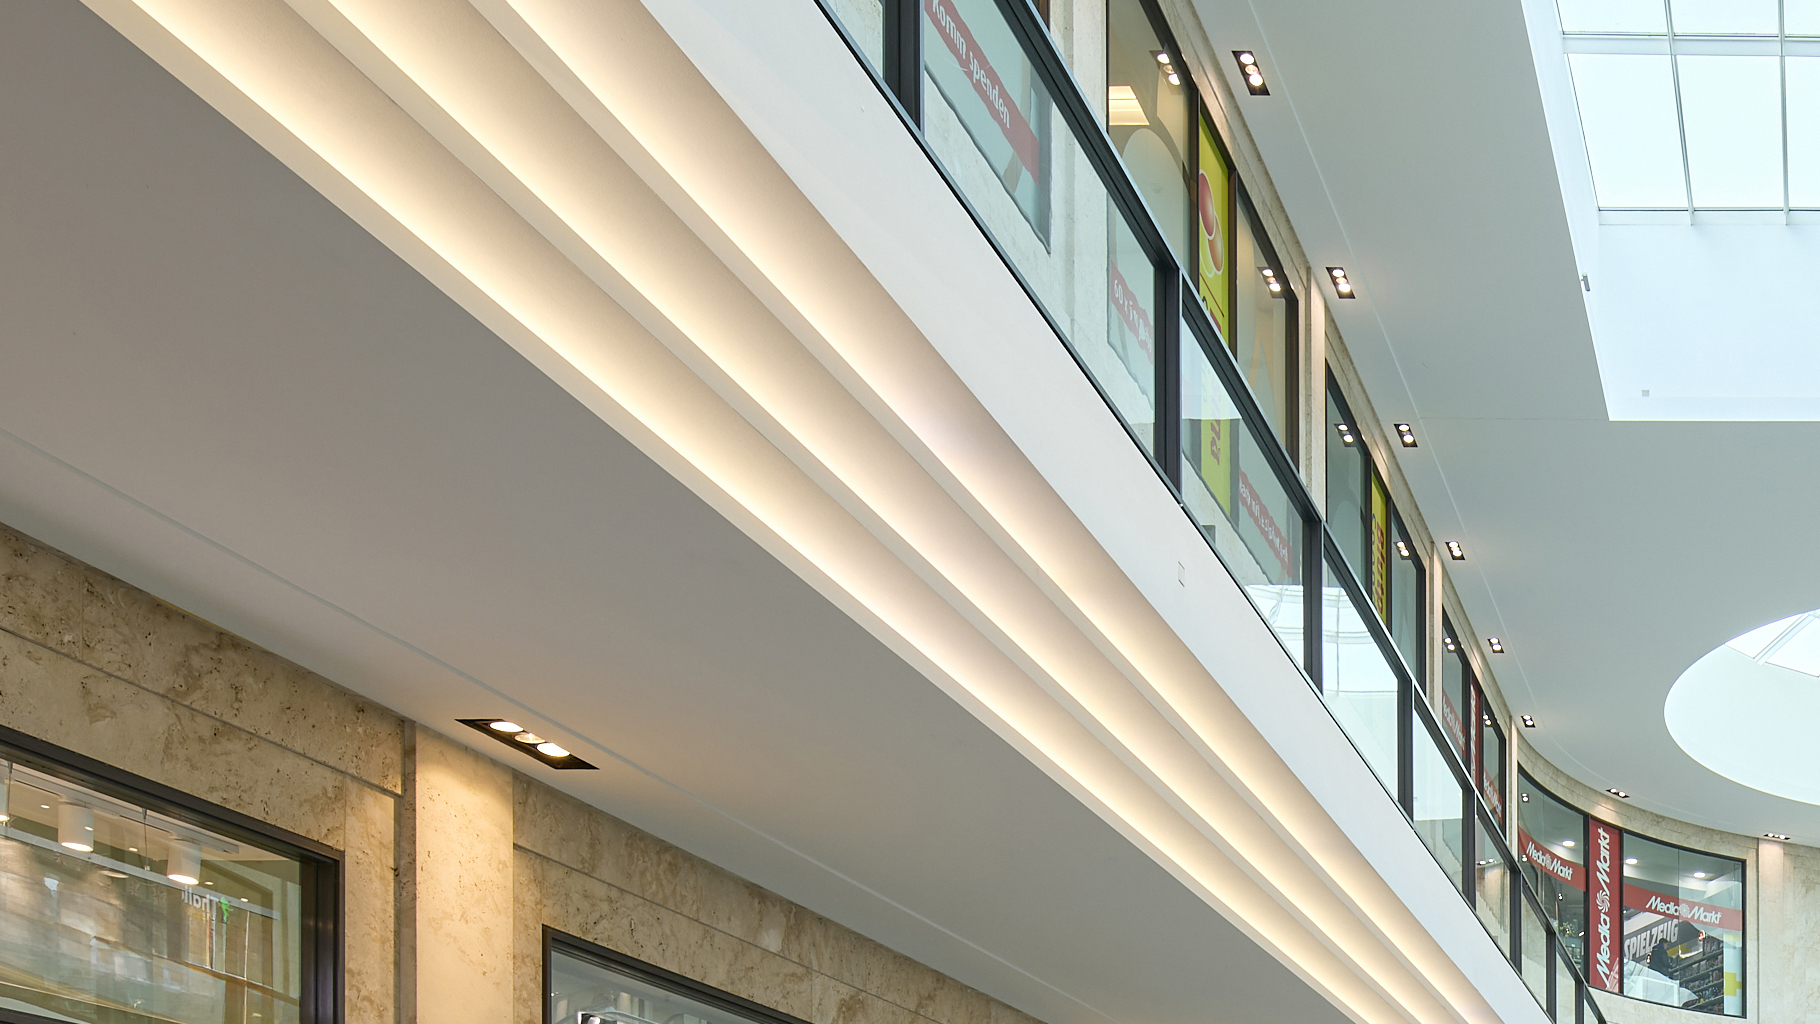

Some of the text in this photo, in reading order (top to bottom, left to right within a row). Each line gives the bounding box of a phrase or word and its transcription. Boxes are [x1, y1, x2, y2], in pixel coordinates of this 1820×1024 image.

[932, 0, 1010, 129] Komm spenden
[1526, 841, 1573, 881] Media Markt
[1596, 827, 1611, 990] Media Markt
[1646, 895, 1722, 925] Media Markt
[1624, 918, 1679, 961] SPIELZEUG
